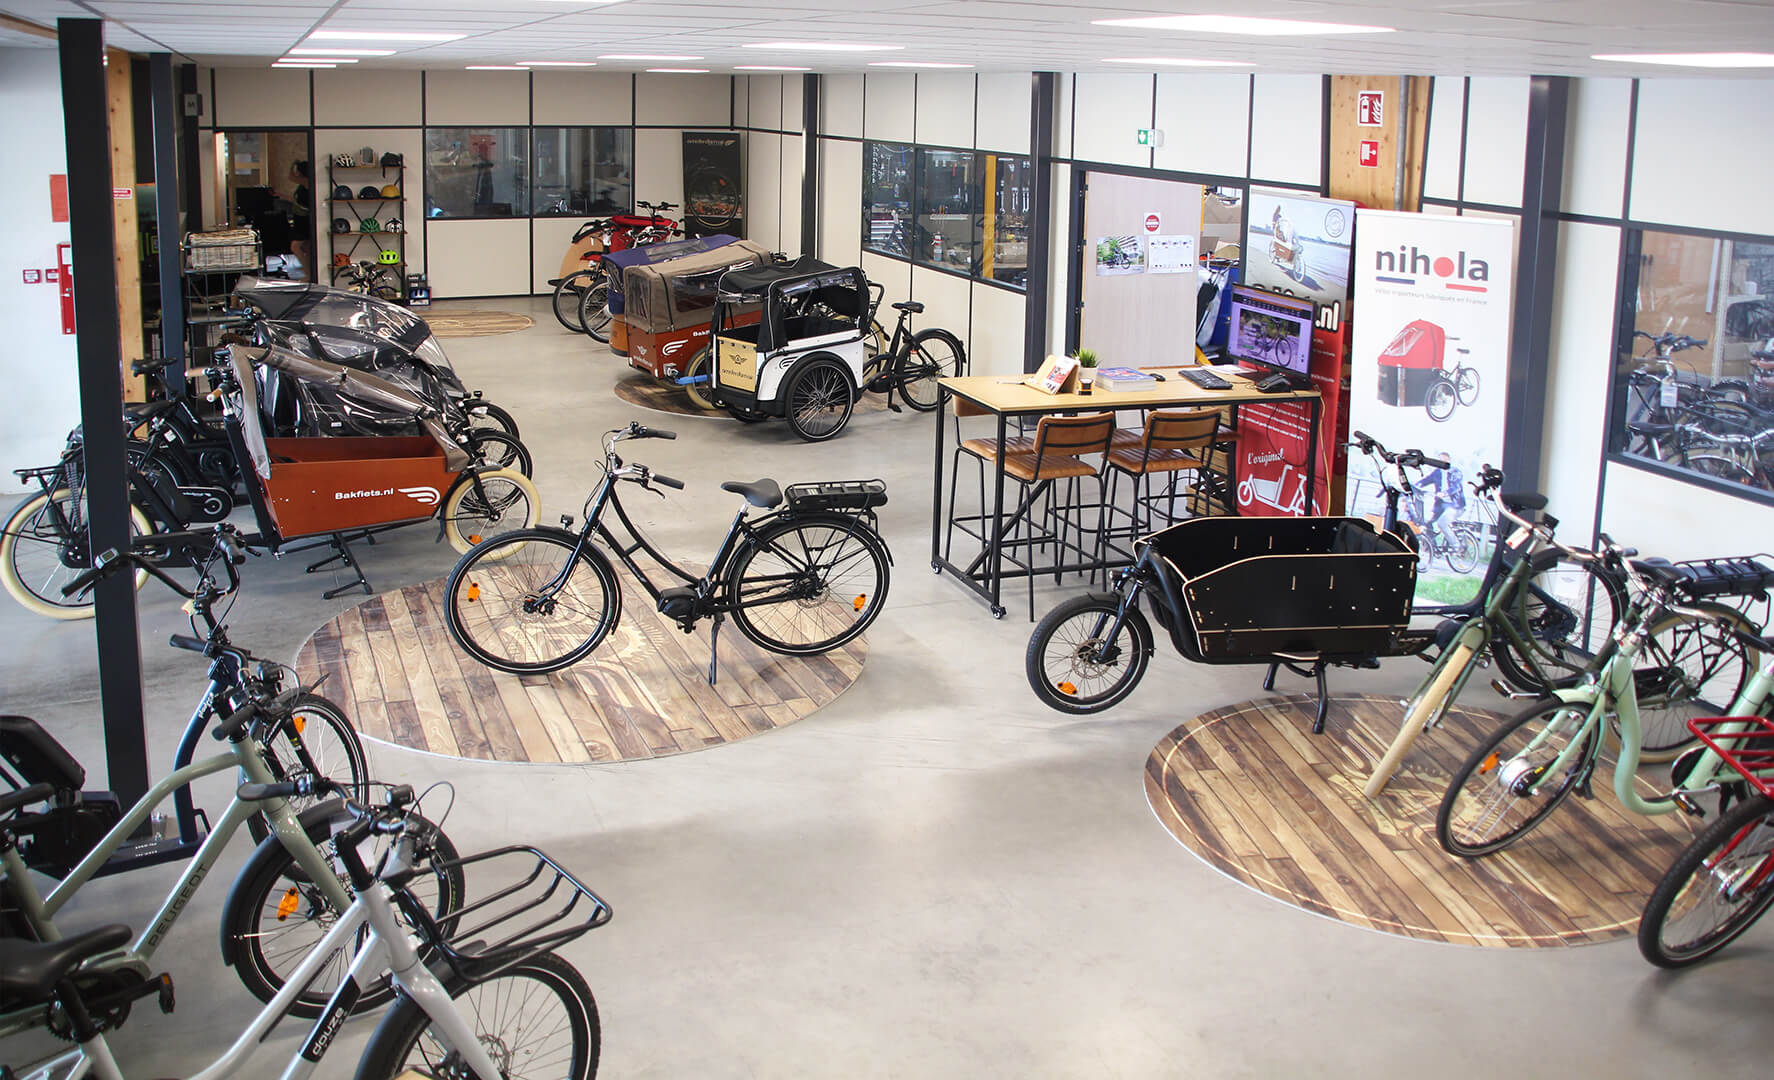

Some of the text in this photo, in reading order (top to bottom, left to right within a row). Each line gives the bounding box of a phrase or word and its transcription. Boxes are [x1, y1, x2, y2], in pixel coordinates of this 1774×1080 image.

[1376, 245, 1489, 281] nihola
[335, 488, 394, 500] Bakfiets.nl
[148, 864, 208, 946] PEUGEOT
[312, 1007, 345, 1056] douze
